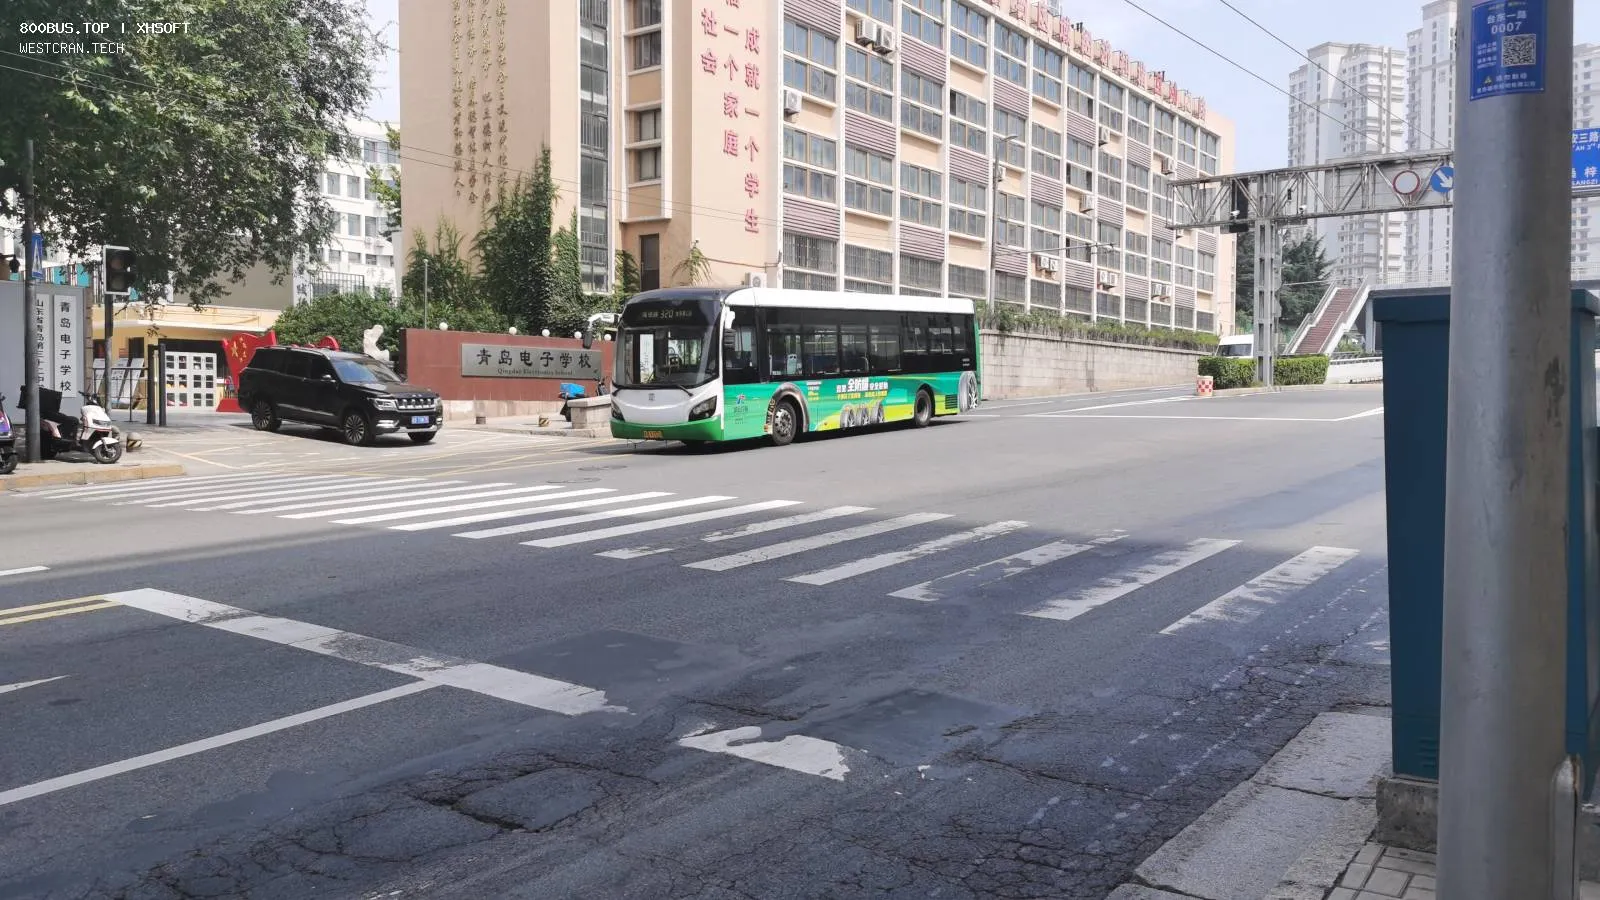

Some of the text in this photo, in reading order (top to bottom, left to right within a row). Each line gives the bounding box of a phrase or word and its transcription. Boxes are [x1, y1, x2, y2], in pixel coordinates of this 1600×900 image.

[1491, 21, 1522, 34] 0007
[744, 27, 760, 233] 成就一个学生
[59, 301, 71, 392] 青岛电子学校
[476, 347, 592, 369] 青岛电子学校
